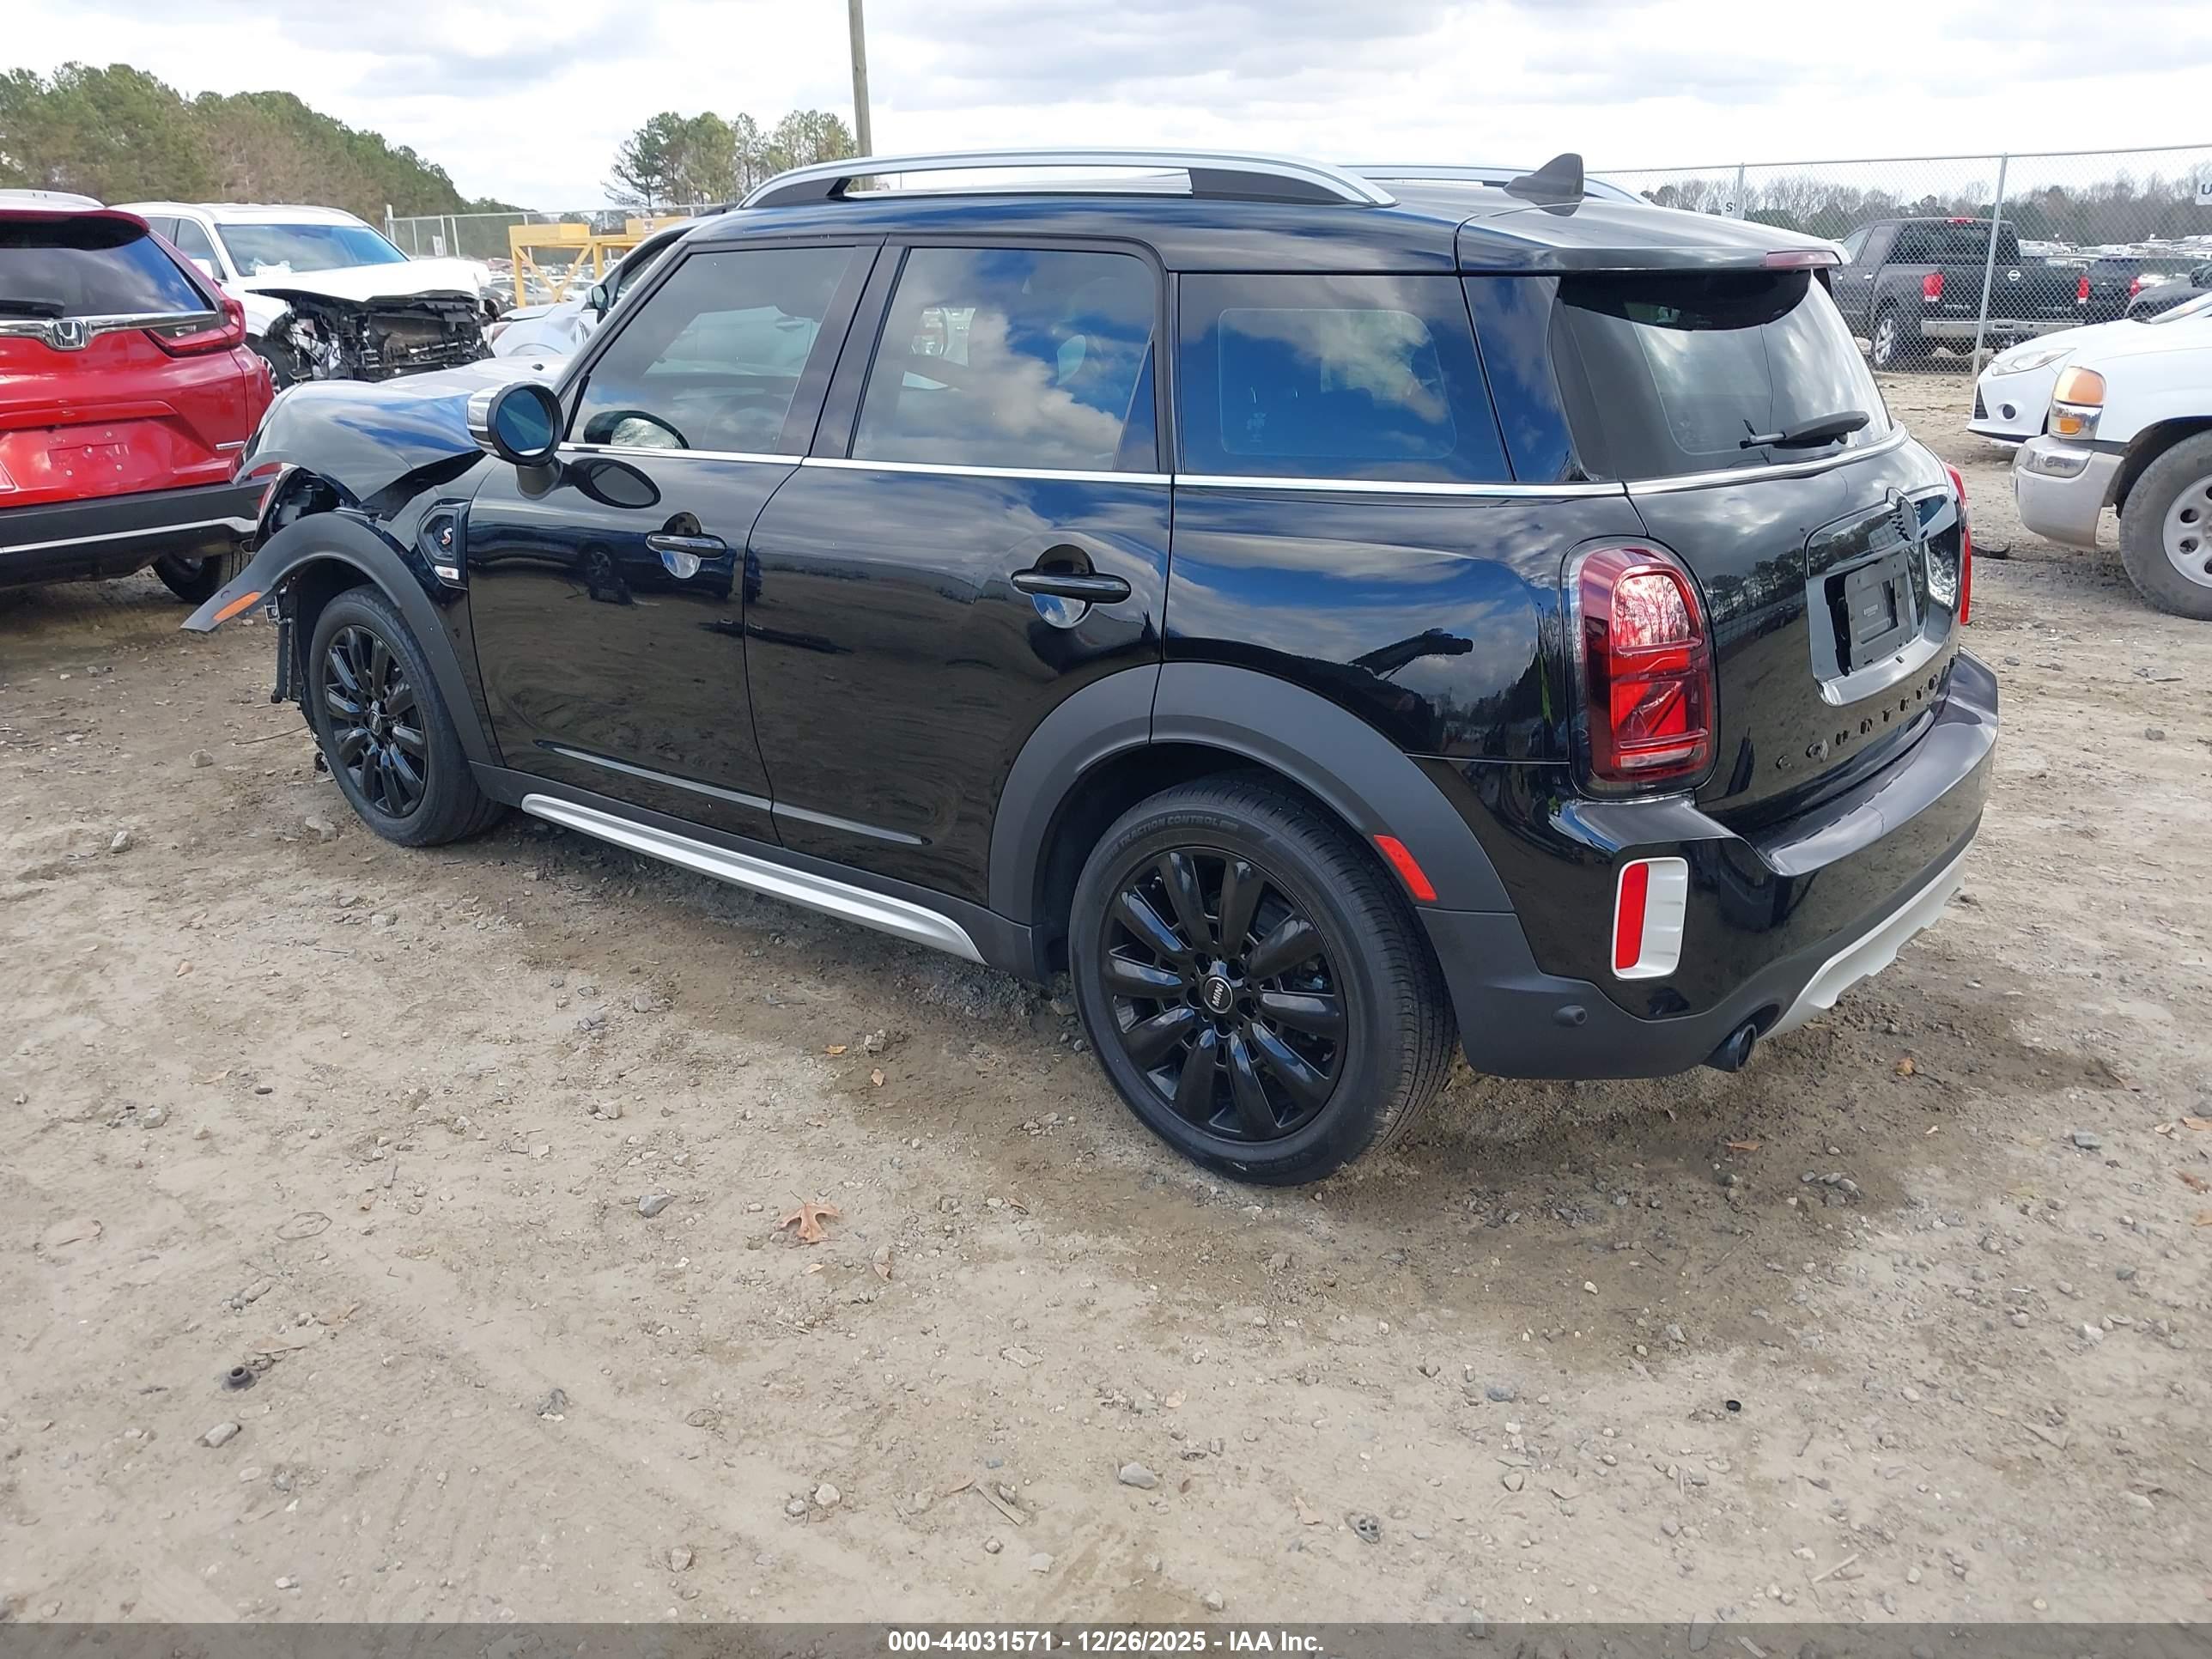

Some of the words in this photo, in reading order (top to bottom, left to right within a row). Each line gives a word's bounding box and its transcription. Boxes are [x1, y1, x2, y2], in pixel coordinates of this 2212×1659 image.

[441, 526, 453, 545] S
[1119, 817, 1166, 847] TRACTION
[1167, 814, 1218, 826] CONTROL
[1211, 981, 1224, 1007] MINI
